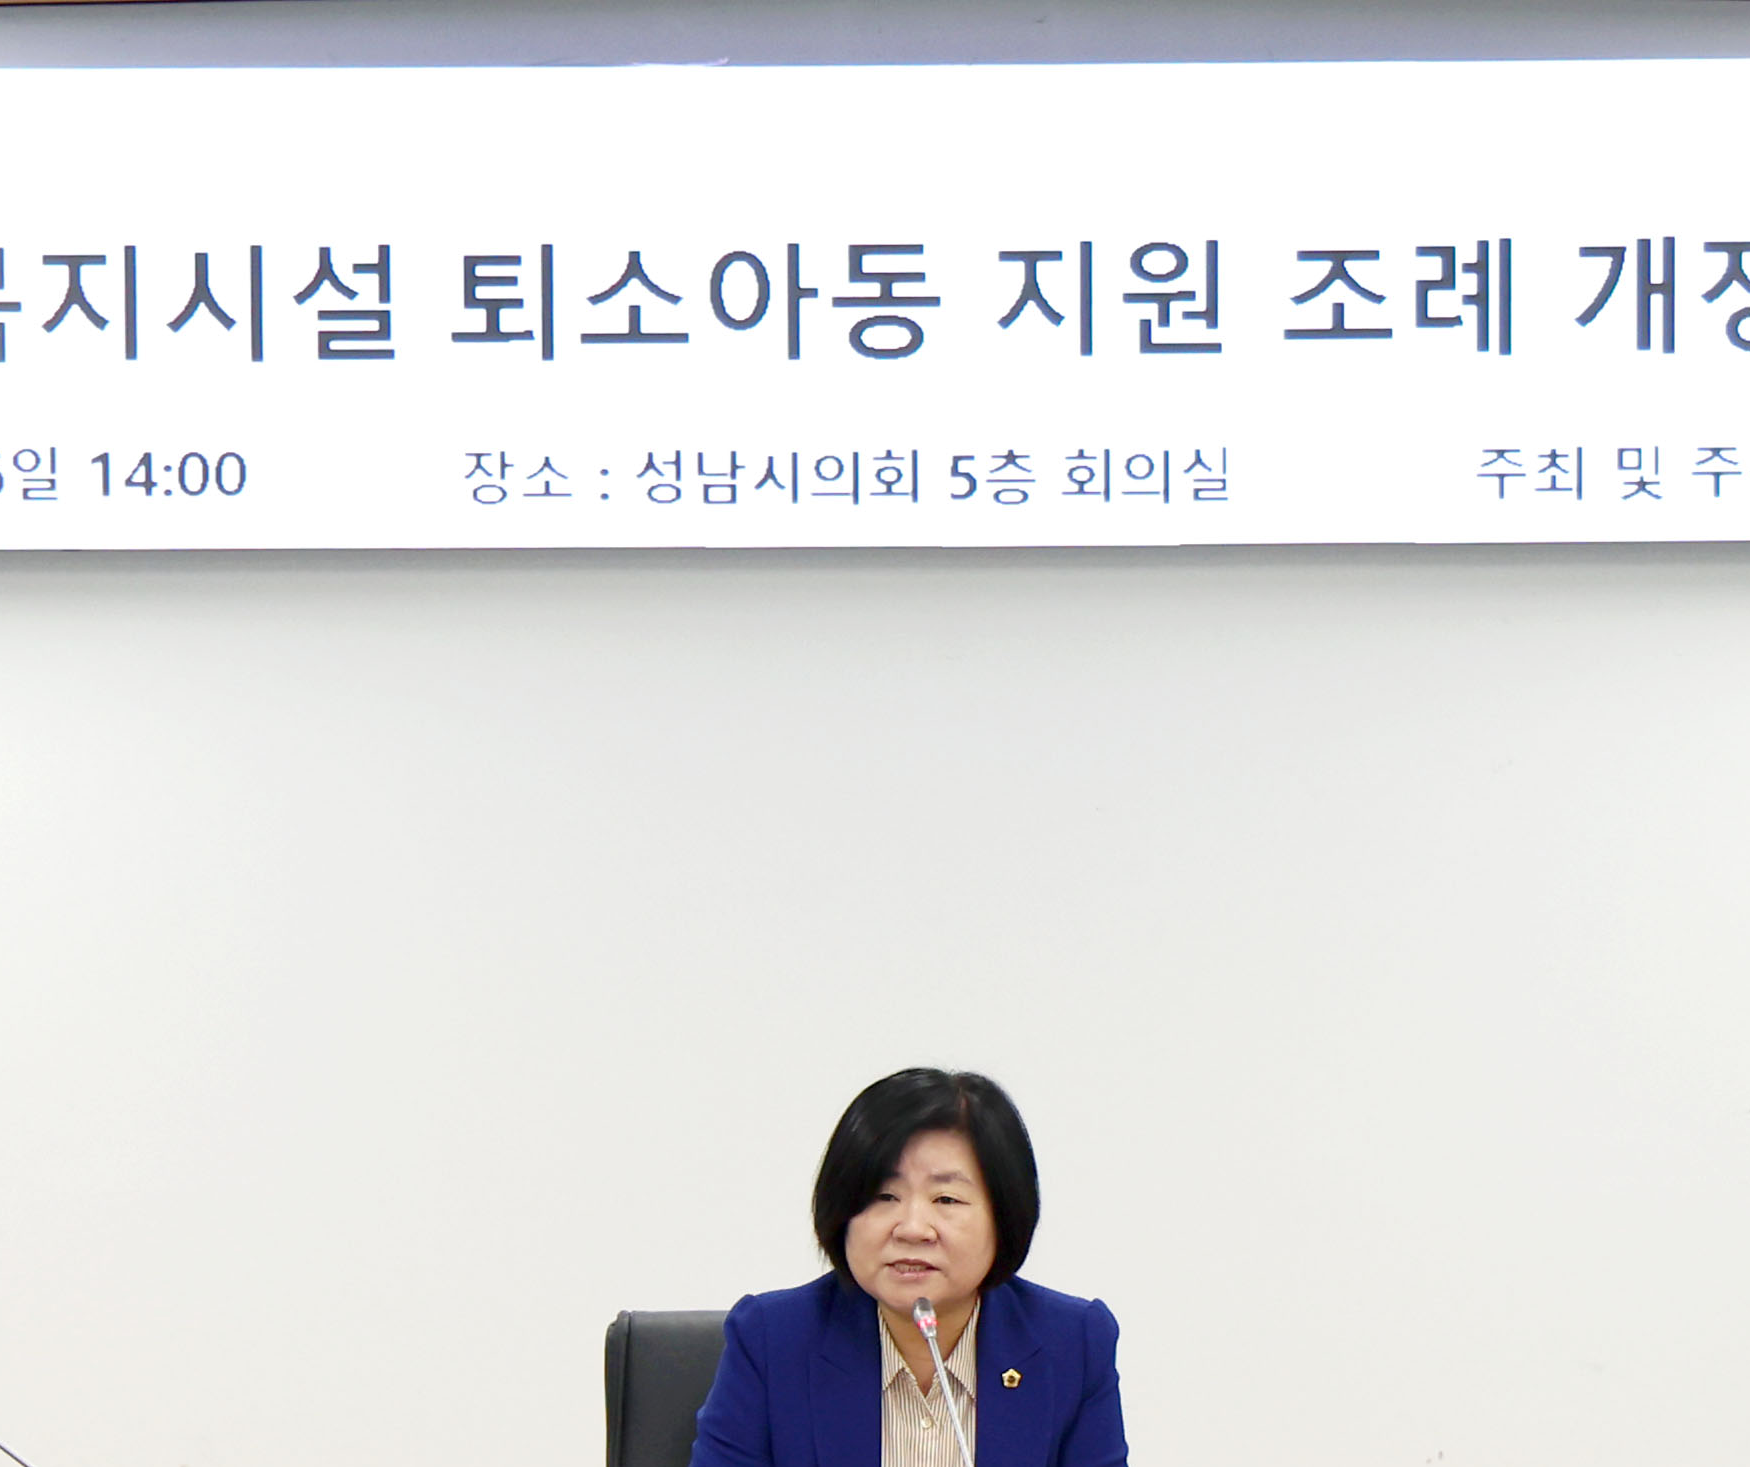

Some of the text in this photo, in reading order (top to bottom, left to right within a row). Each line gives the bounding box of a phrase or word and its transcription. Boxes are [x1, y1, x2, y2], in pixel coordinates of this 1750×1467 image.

[450, 242, 942, 362] 퇴소아동
[997, 240, 1223, 357] 지원
[1283, 237, 1512, 356] 조례
[90, 450, 247, 497] 14:00
[464, 446, 1229, 506] 장소 : 성남시의회 5층 회의실
[1476, 446, 1583, 501] 주최
[1616, 445, 1663, 501] 및
